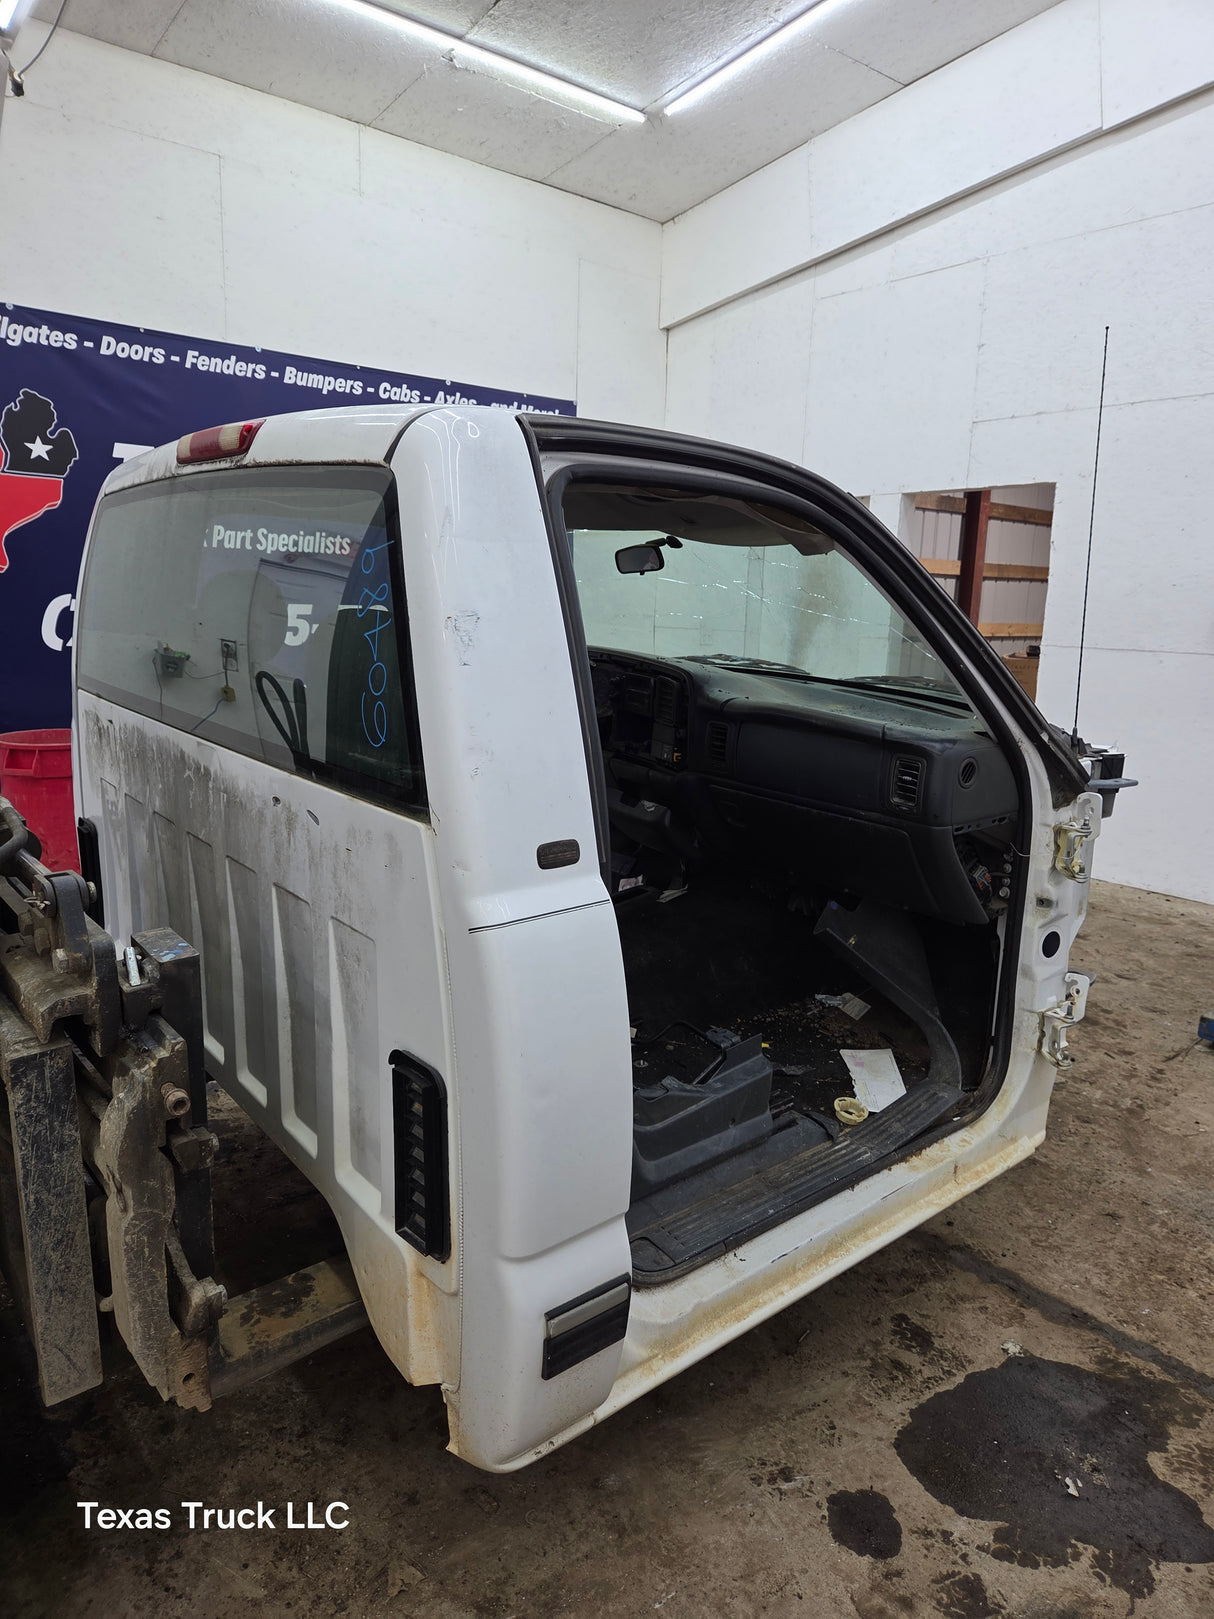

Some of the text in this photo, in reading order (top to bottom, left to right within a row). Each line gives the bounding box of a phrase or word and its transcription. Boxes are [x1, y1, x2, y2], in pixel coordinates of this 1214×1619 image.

[0, 314, 78, 350] lgates
[99, 335, 165, 364] Doors
[185, 349, 266, 380] Fenders
[283, 365, 363, 395] Bumpers
[378, 382, 420, 404] Cabs
[212, 524, 253, 550] Part
[256, 527, 351, 555] Specialists
